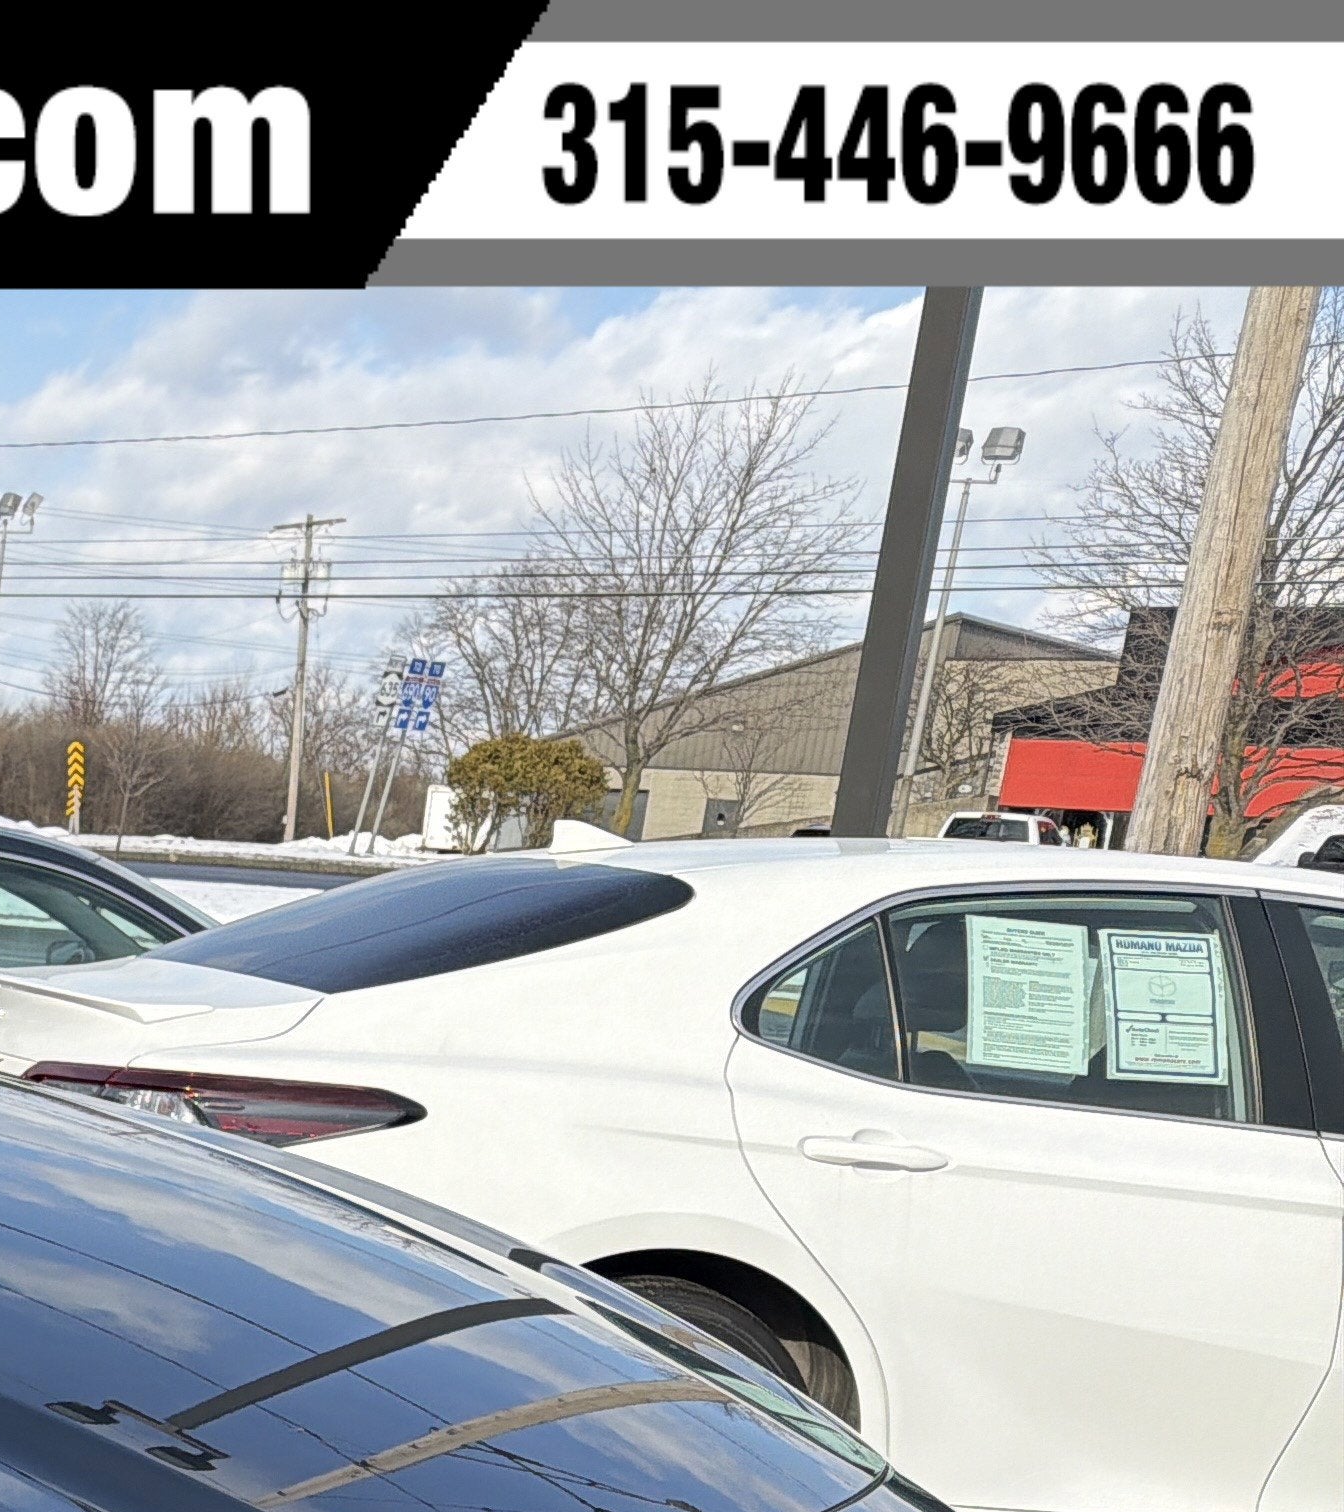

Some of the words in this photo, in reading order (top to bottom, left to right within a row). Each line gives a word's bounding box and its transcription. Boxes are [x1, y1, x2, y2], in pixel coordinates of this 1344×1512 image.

[380, 681, 399, 697] 635
[403, 683, 422, 699] 690
[424, 686, 437, 702] 90
[1115, 939, 1162, 951] ROMANO
[1165, 941, 1204, 953] MAZDA
